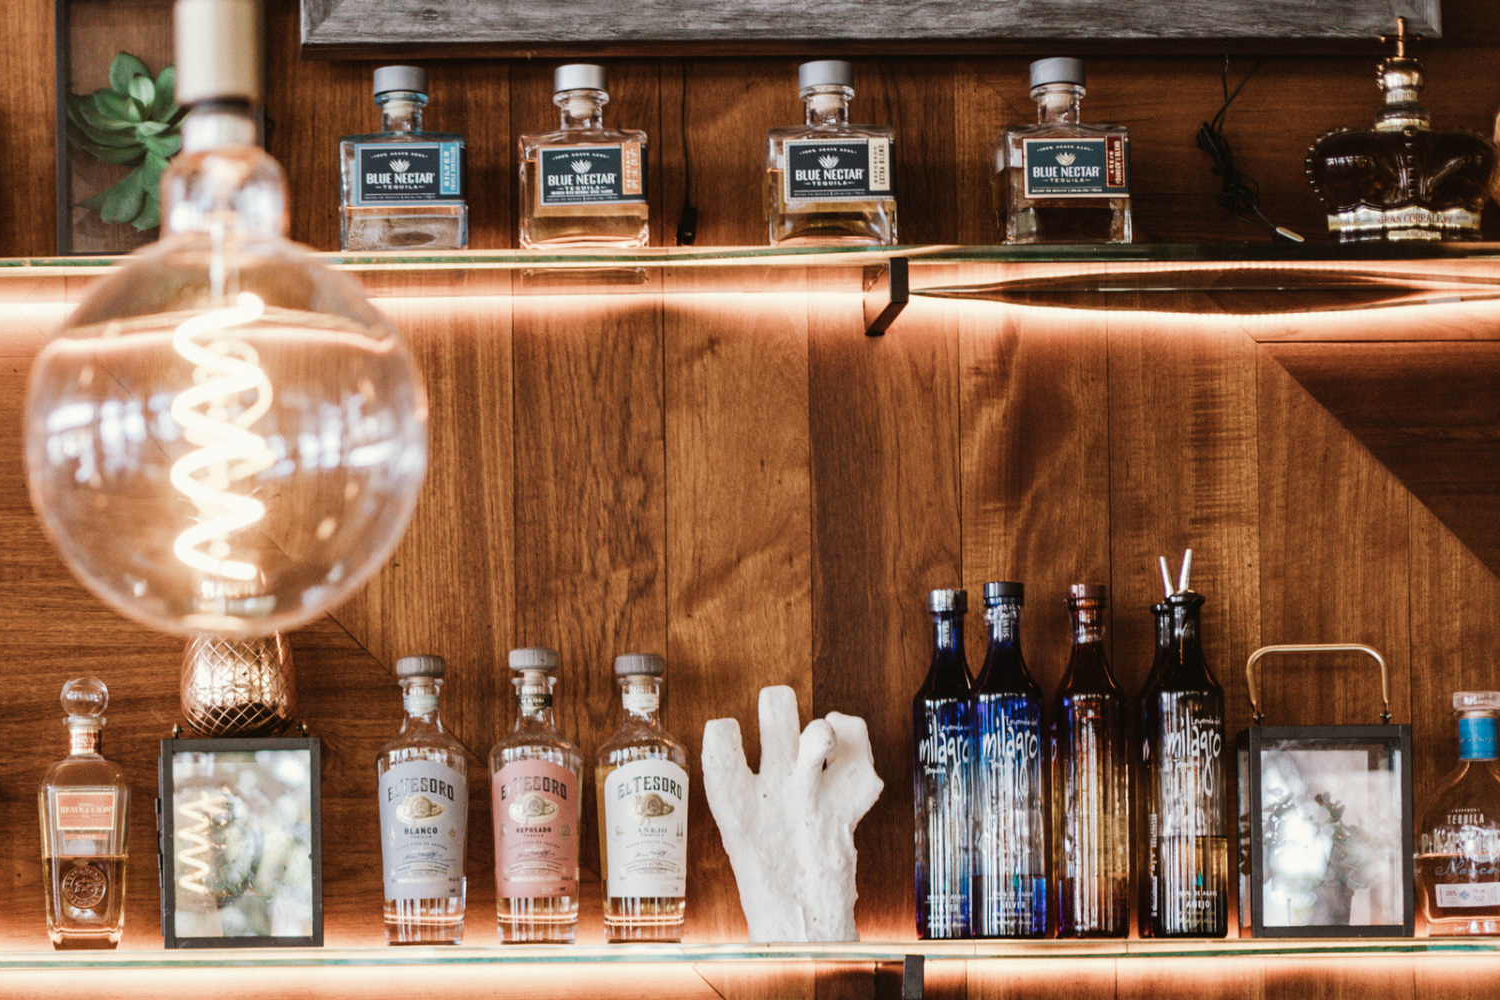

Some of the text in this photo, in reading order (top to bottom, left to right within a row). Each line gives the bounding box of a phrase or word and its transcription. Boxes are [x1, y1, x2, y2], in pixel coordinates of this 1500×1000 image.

[366, 172, 434, 184] BLUE NECTAR
[795, 168, 862, 181] BLUE NECTAR
[1032, 166, 1100, 178] BLUE NECTAR
[548, 173, 614, 186] BLUE NECTAR
[1378, 215, 1401, 224] GRAN
[919, 714, 969, 801] milagro
[982, 708, 1038, 798] milagro
[1166, 708, 1222, 798] milagro
[402, 778, 454, 801] TESORO
[514, 776, 567, 800] TESORO
[618, 776, 682, 800] EL TESORO
[60, 806, 112, 814] REVOLUCIÓN
[1447, 814, 1484, 824] TEQUILA
[637, 826, 668, 834] AÑEJO
[1186, 898, 1210, 908] AÑEJO
